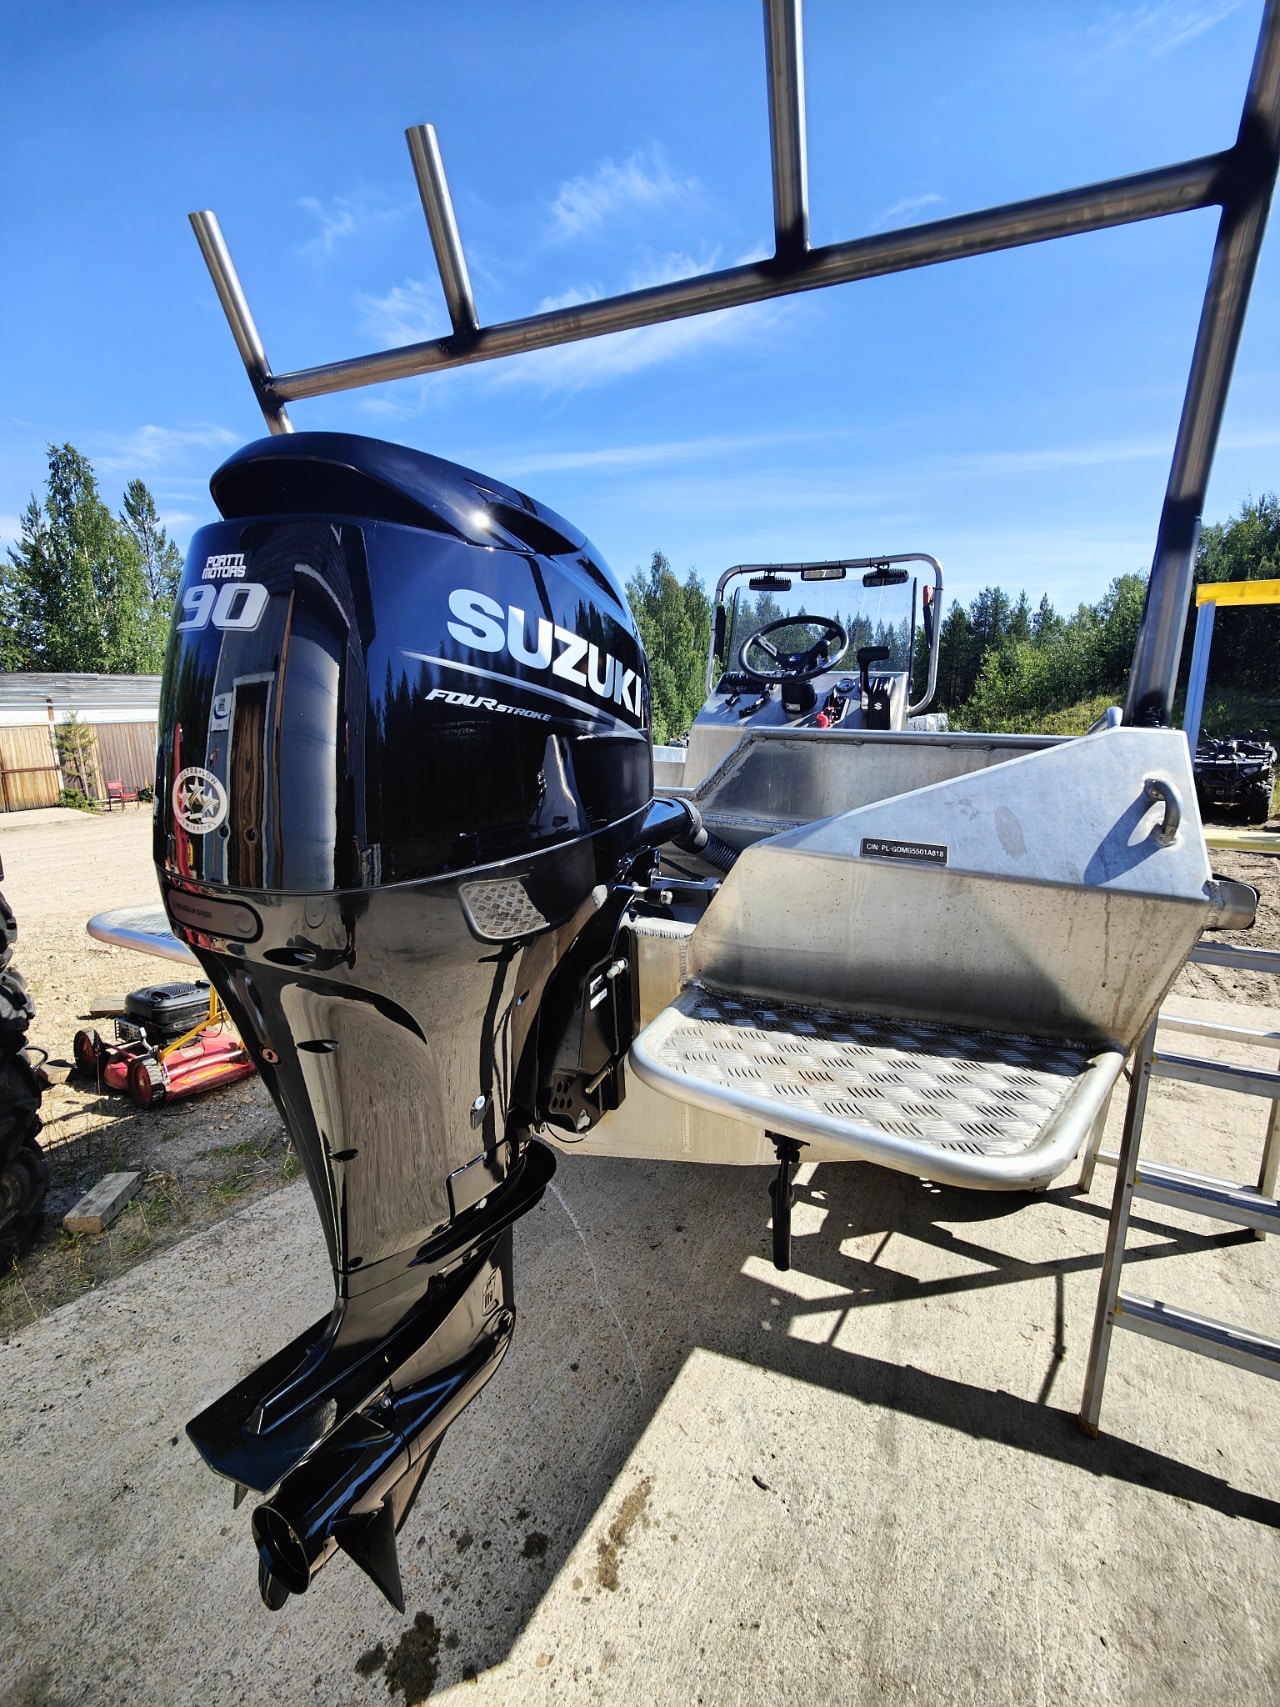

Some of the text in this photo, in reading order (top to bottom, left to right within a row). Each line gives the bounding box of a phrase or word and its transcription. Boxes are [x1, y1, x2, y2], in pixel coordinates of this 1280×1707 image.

[202, 565, 247, 579] MOTORS
[206, 553, 245, 567] PORTTI
[176, 583, 270, 632] 90
[447, 588, 642, 718] SUZUKI
